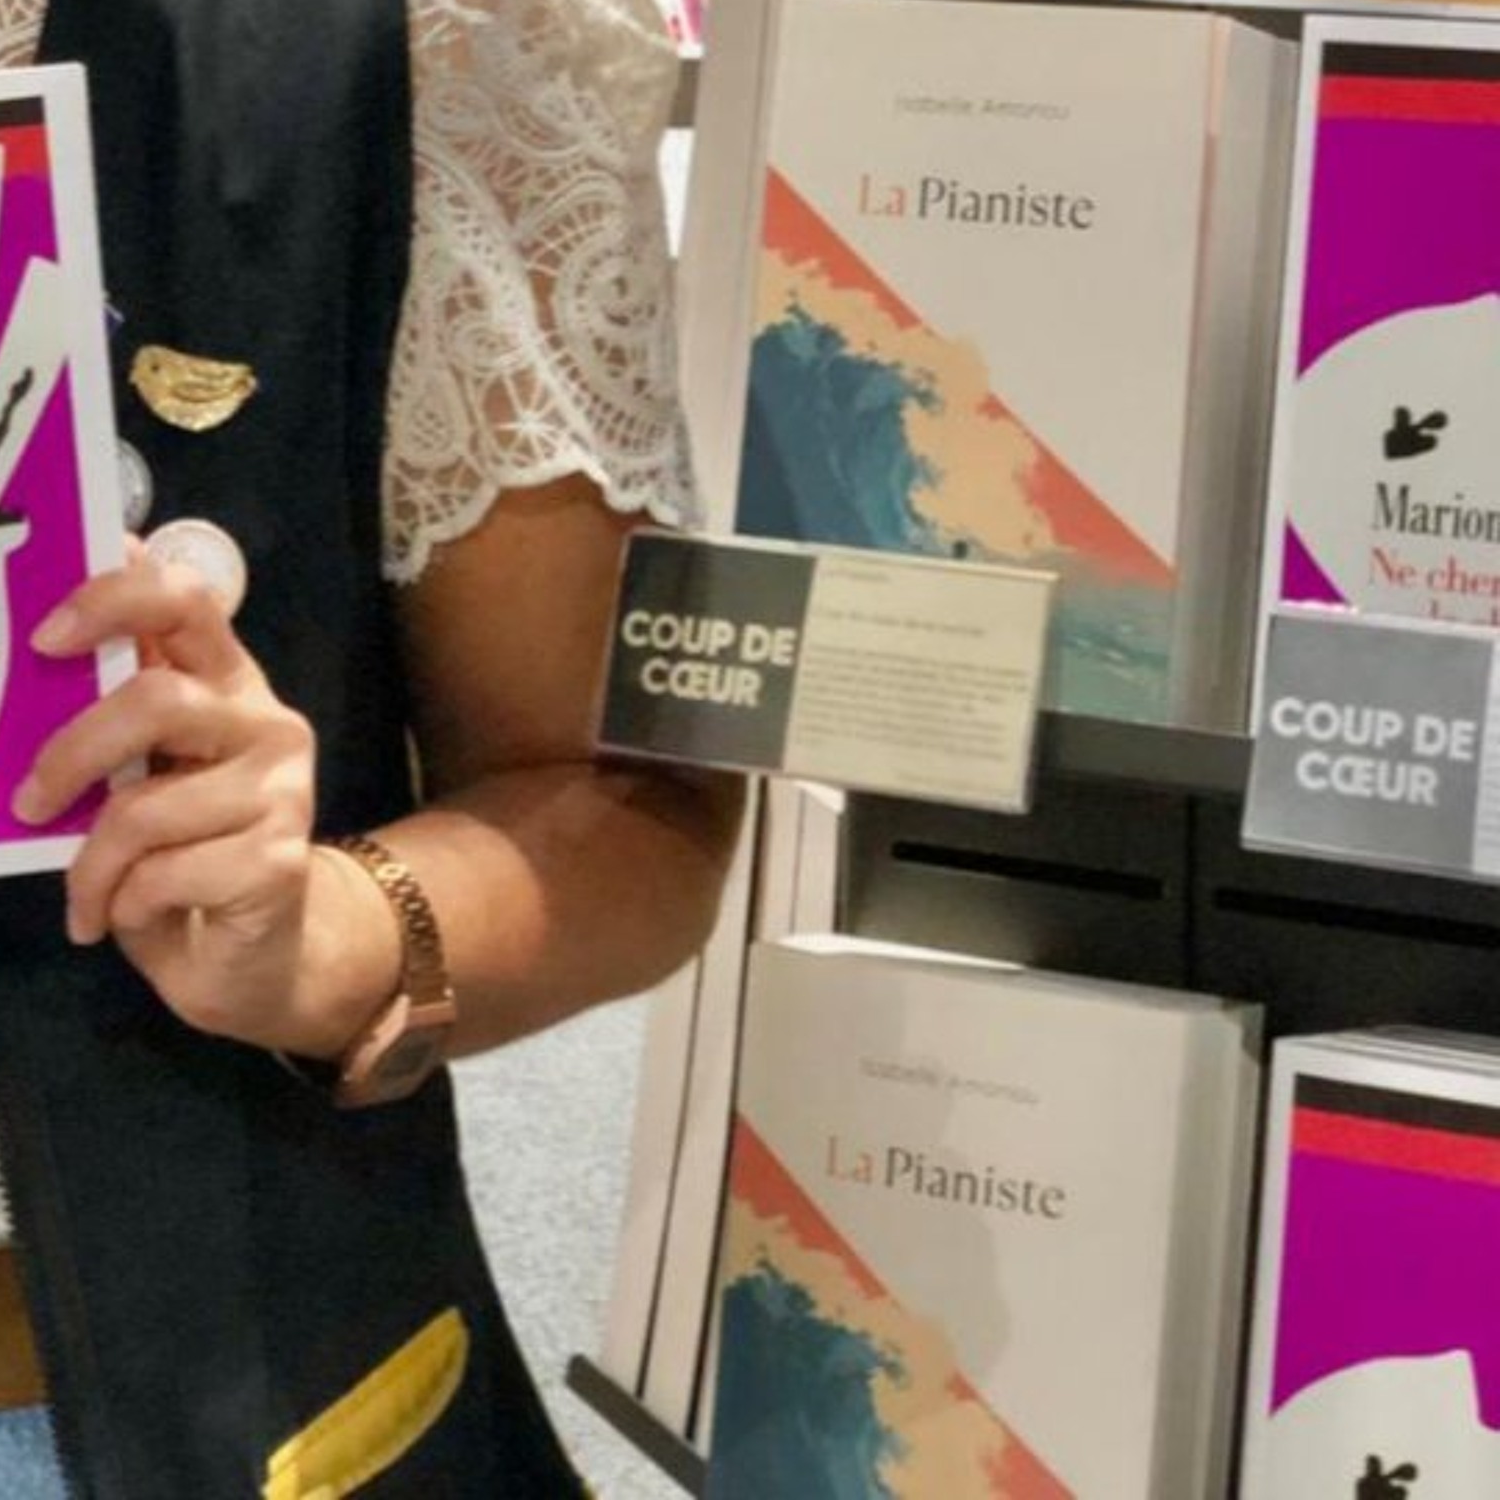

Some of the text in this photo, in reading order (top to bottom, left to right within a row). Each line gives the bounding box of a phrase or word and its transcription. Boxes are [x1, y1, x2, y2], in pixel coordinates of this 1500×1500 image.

[858, 173, 1096, 231] La Pianiste
[1370, 547, 1416, 587] Ne
[622, 609, 798, 668] COUP DE
[639, 655, 763, 709] CŒUR
[1270, 696, 1478, 761] COUP DE
[1295, 750, 1440, 807] CŒUR
[825, 1135, 1067, 1220] La Pianiste
